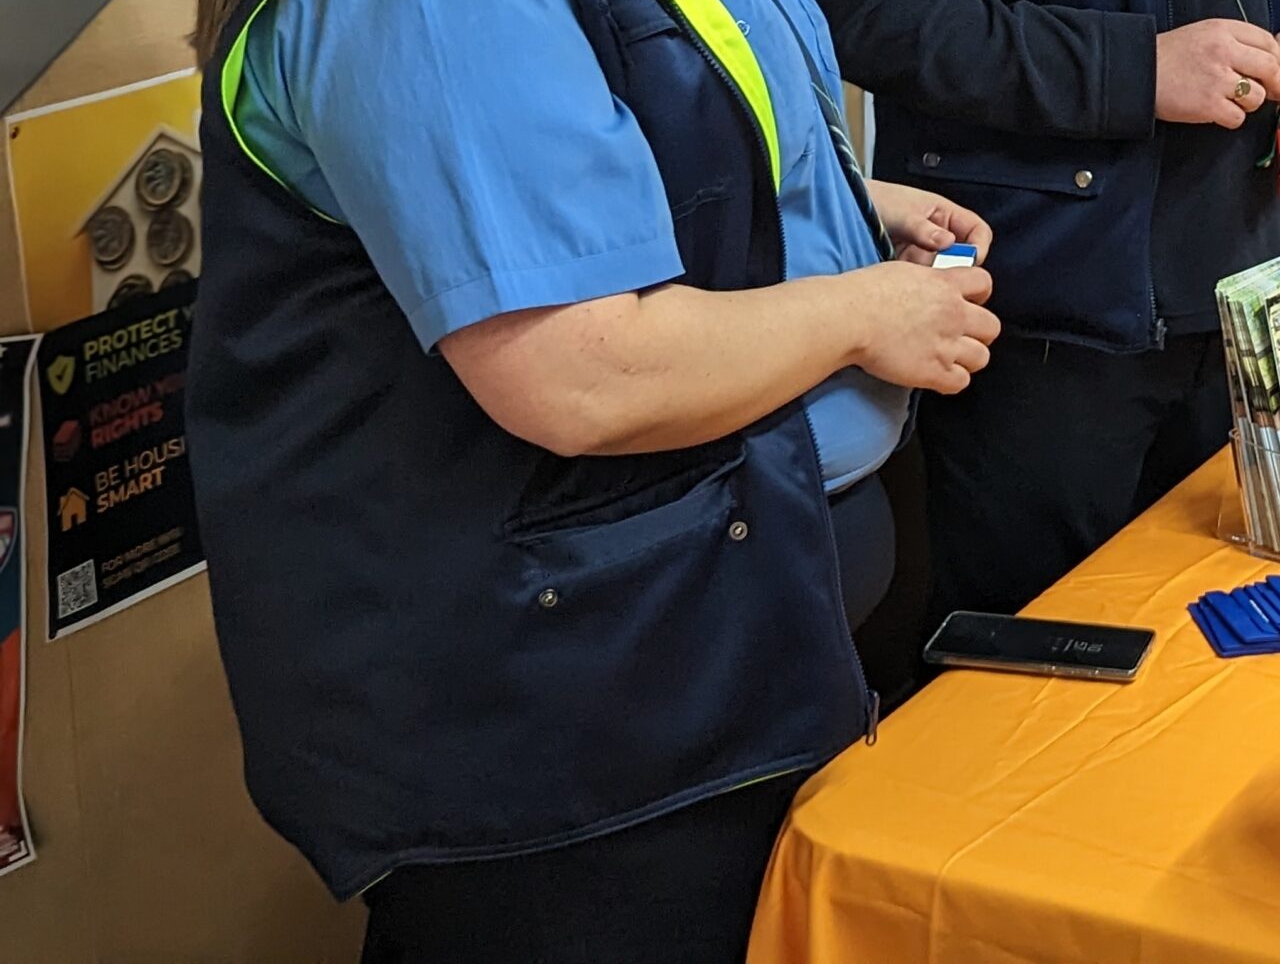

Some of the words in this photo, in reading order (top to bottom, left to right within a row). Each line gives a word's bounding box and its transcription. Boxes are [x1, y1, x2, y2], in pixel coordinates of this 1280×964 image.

[84, 309, 179, 361] PROTECT
[86, 329, 183, 383] FINANCES
[90, 384, 152, 426] KNOW
[91, 401, 164, 449] RIGHTS
[95, 464, 121, 493] BE
[97, 466, 166, 514] SMART
